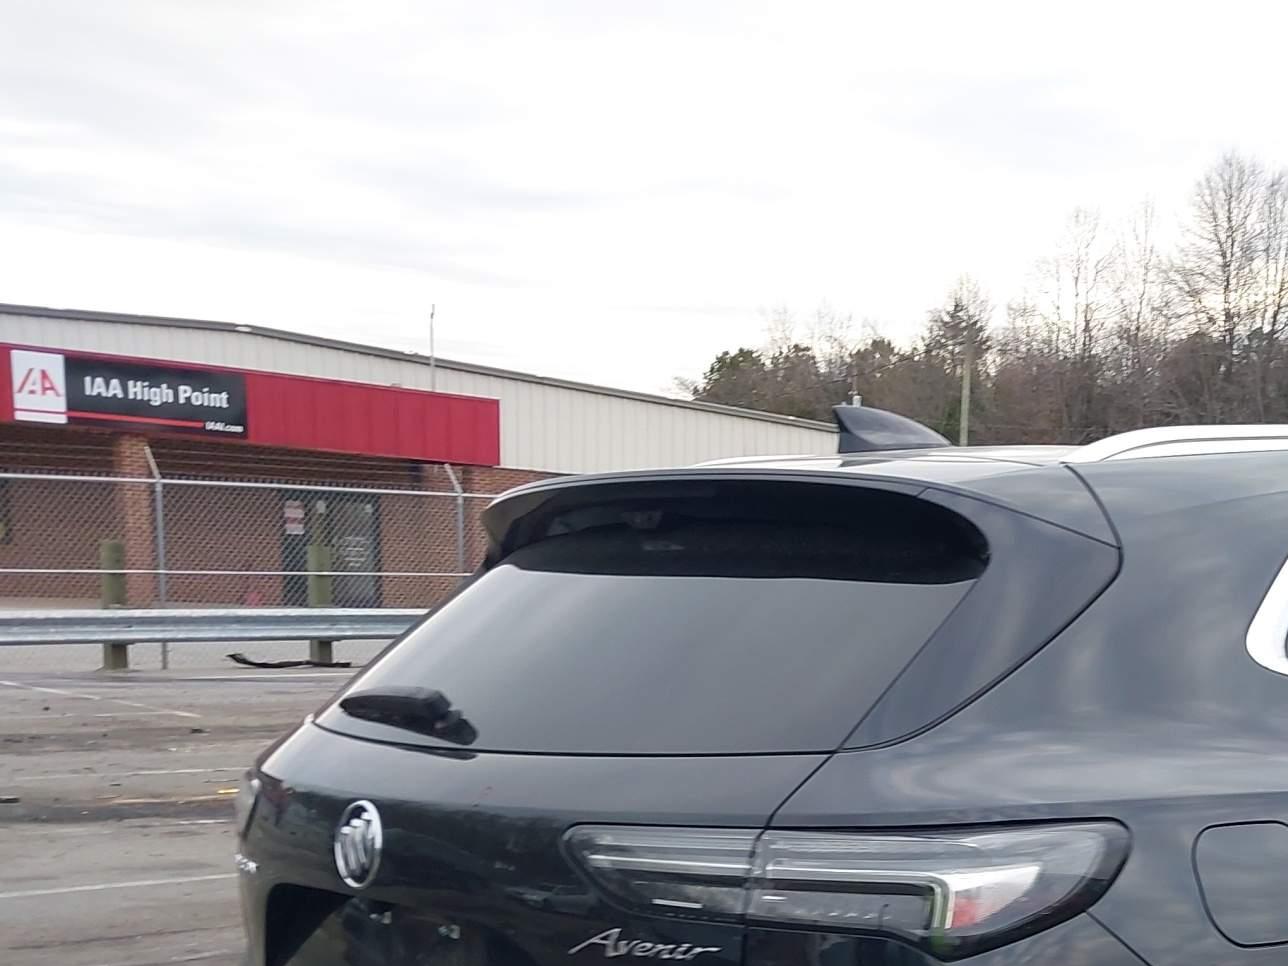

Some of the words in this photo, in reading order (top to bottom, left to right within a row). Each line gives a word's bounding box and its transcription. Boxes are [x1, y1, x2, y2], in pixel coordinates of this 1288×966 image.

[84, 376, 124, 399] IAA
[128, 380, 174, 406] High
[178, 385, 230, 409] Point
[567, 928, 722, 960] Avenir
